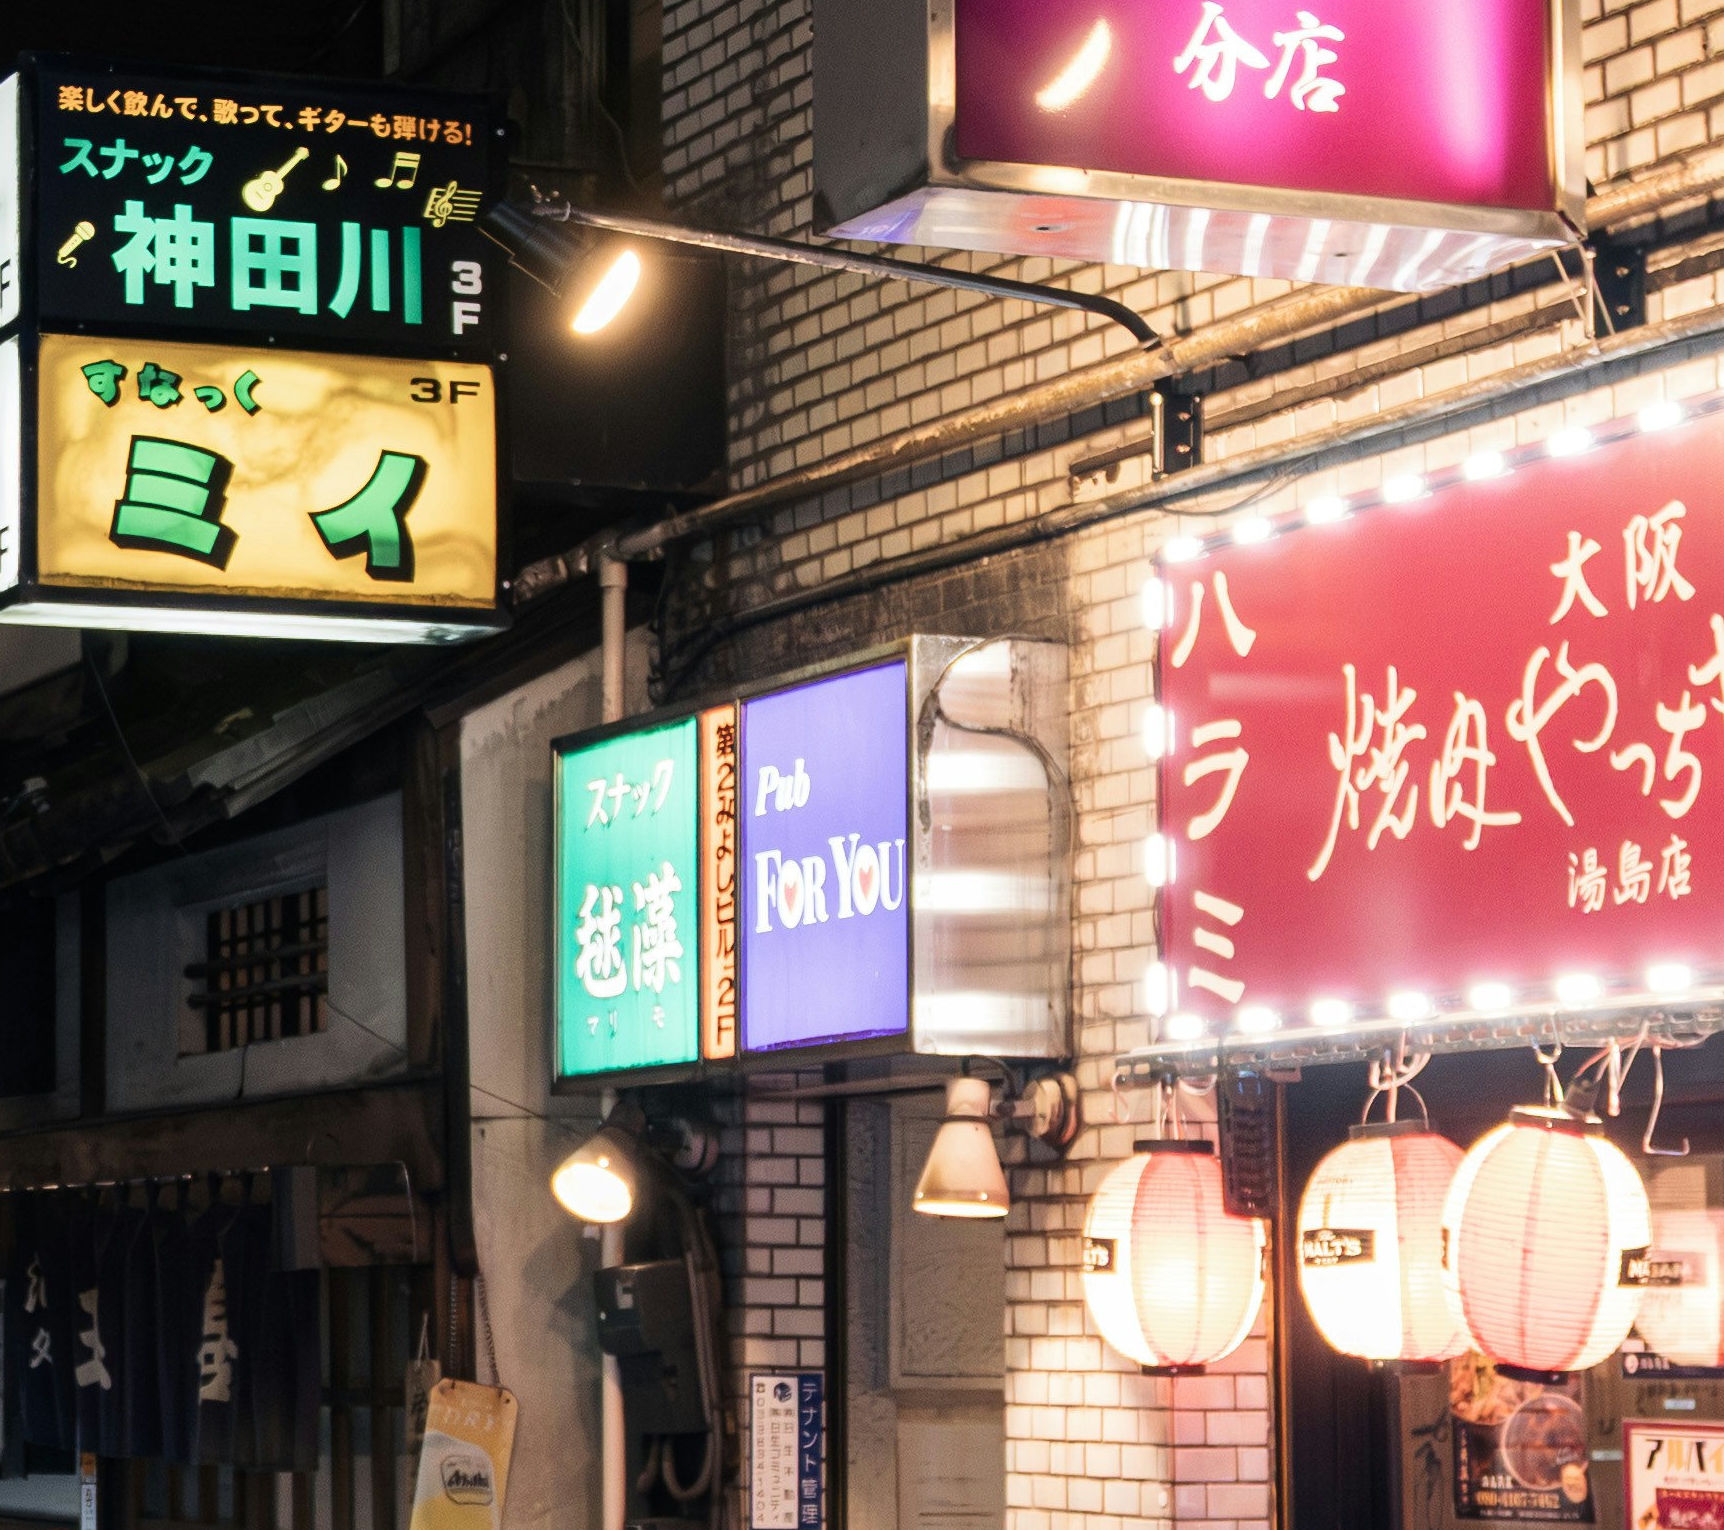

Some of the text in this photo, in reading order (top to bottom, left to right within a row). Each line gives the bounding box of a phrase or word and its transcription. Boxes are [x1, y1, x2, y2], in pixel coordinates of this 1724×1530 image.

[1174, 1, 1347, 113] 分店
[59, 137, 214, 186] スナック
[111, 200, 422, 325] 神田川
[451, 260, 483, 335] 3F
[81, 359, 264, 416] すなっく
[409, 376, 482, 405] 3F
[109, 434, 430, 583] ミイ
[1550, 500, 1696, 624] 大阪
[754, 757, 811, 817] Pub
[1172, 570, 1258, 1005] ハラミ
[1307, 612, 1724, 881] 焼肉やっち
[586, 757, 676, 830] スナック
[754, 832, 905, 934] FOR YOU
[1567, 834, 1692, 914] 湯島店
[587, 1008, 666, 1036] マリモ
[801, 1381, 819, 1525] テナント管理
